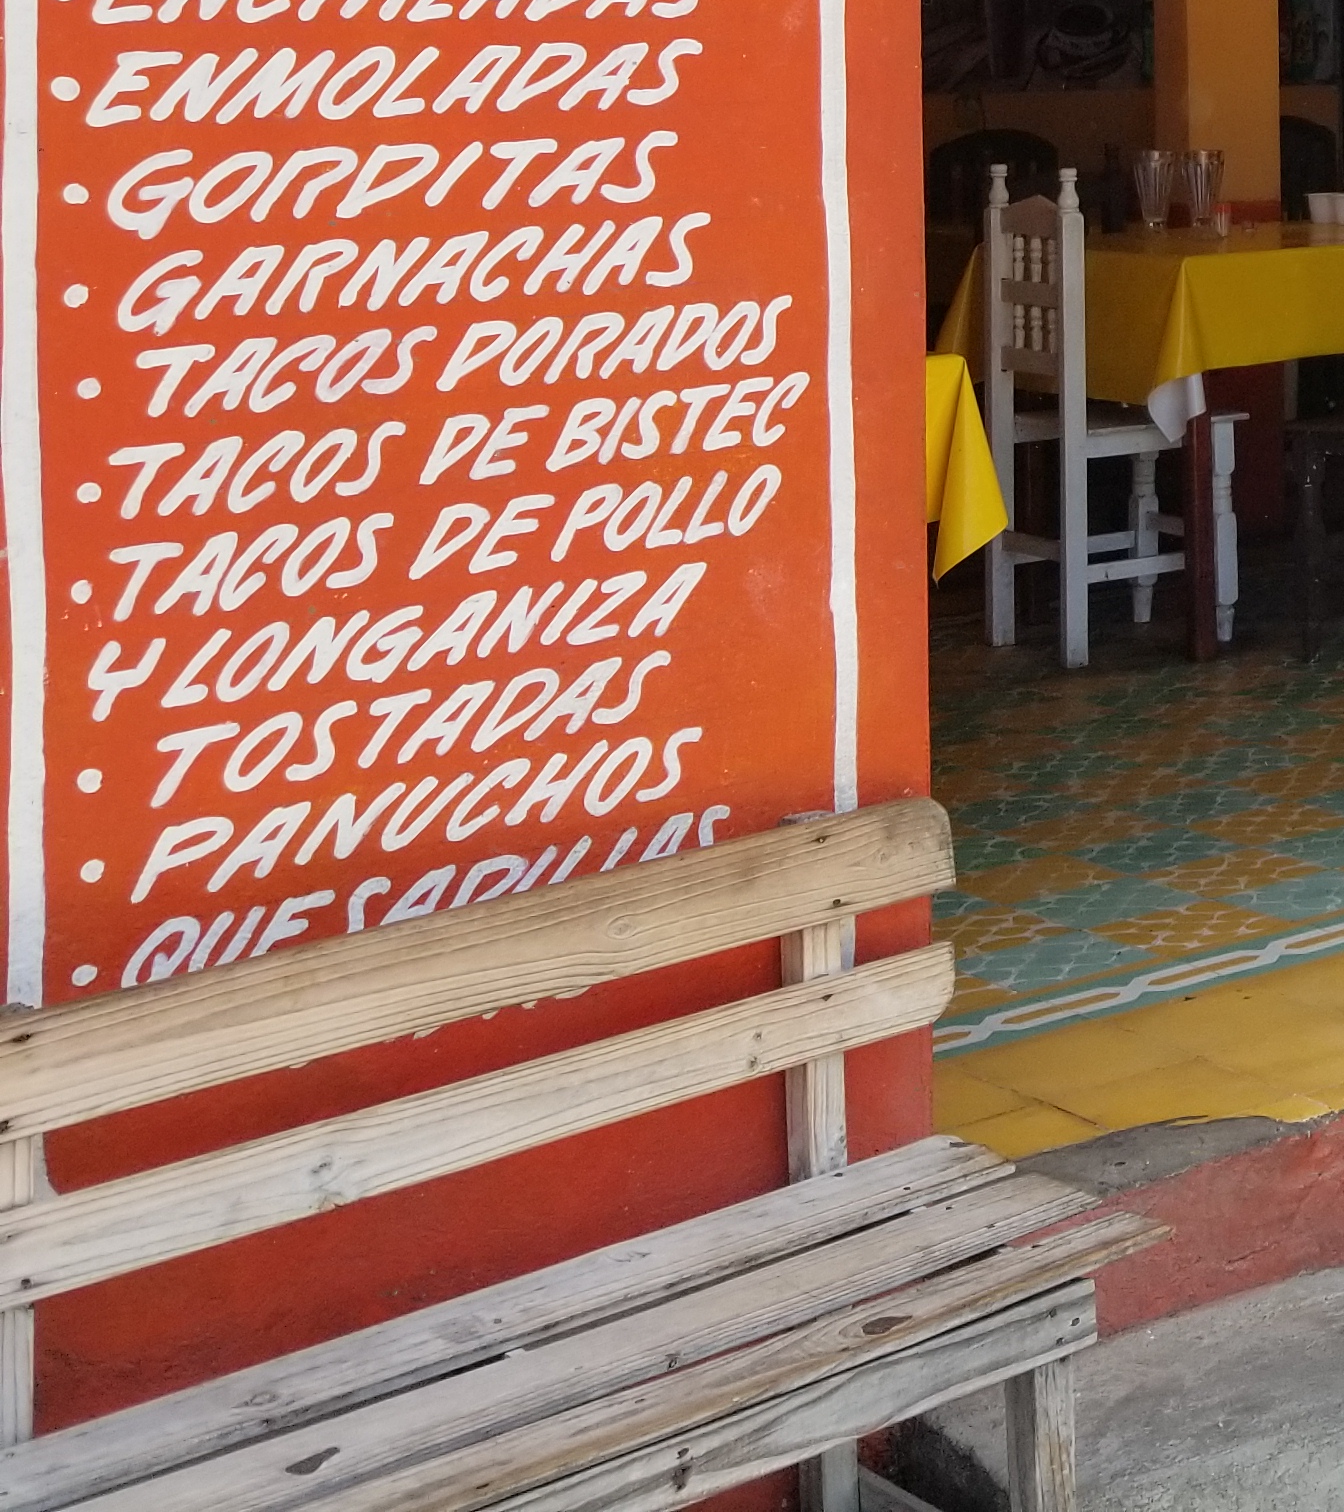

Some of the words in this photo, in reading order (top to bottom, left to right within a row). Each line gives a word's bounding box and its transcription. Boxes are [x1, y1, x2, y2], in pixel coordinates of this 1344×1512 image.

[86, 39, 704, 128] ENMOLADAS
[118, 212, 713, 334] GARNACHAS
[137, 325, 436, 417] TACOS
[436, 294, 793, 393] DORADOS
[108, 422, 407, 519] TACOS
[419, 404, 551, 486] DE
[546, 371, 811, 472] BISTEC
[110, 512, 394, 621] TACOS
[409, 493, 557, 581] DE
[552, 463, 783, 564] POLLO
[88, 636, 167, 722] Y
[160, 561, 707, 710] LONGANIZA
[151, 650, 671, 809] TOSTADAS
[130, 727, 703, 904] PANUCHOS
